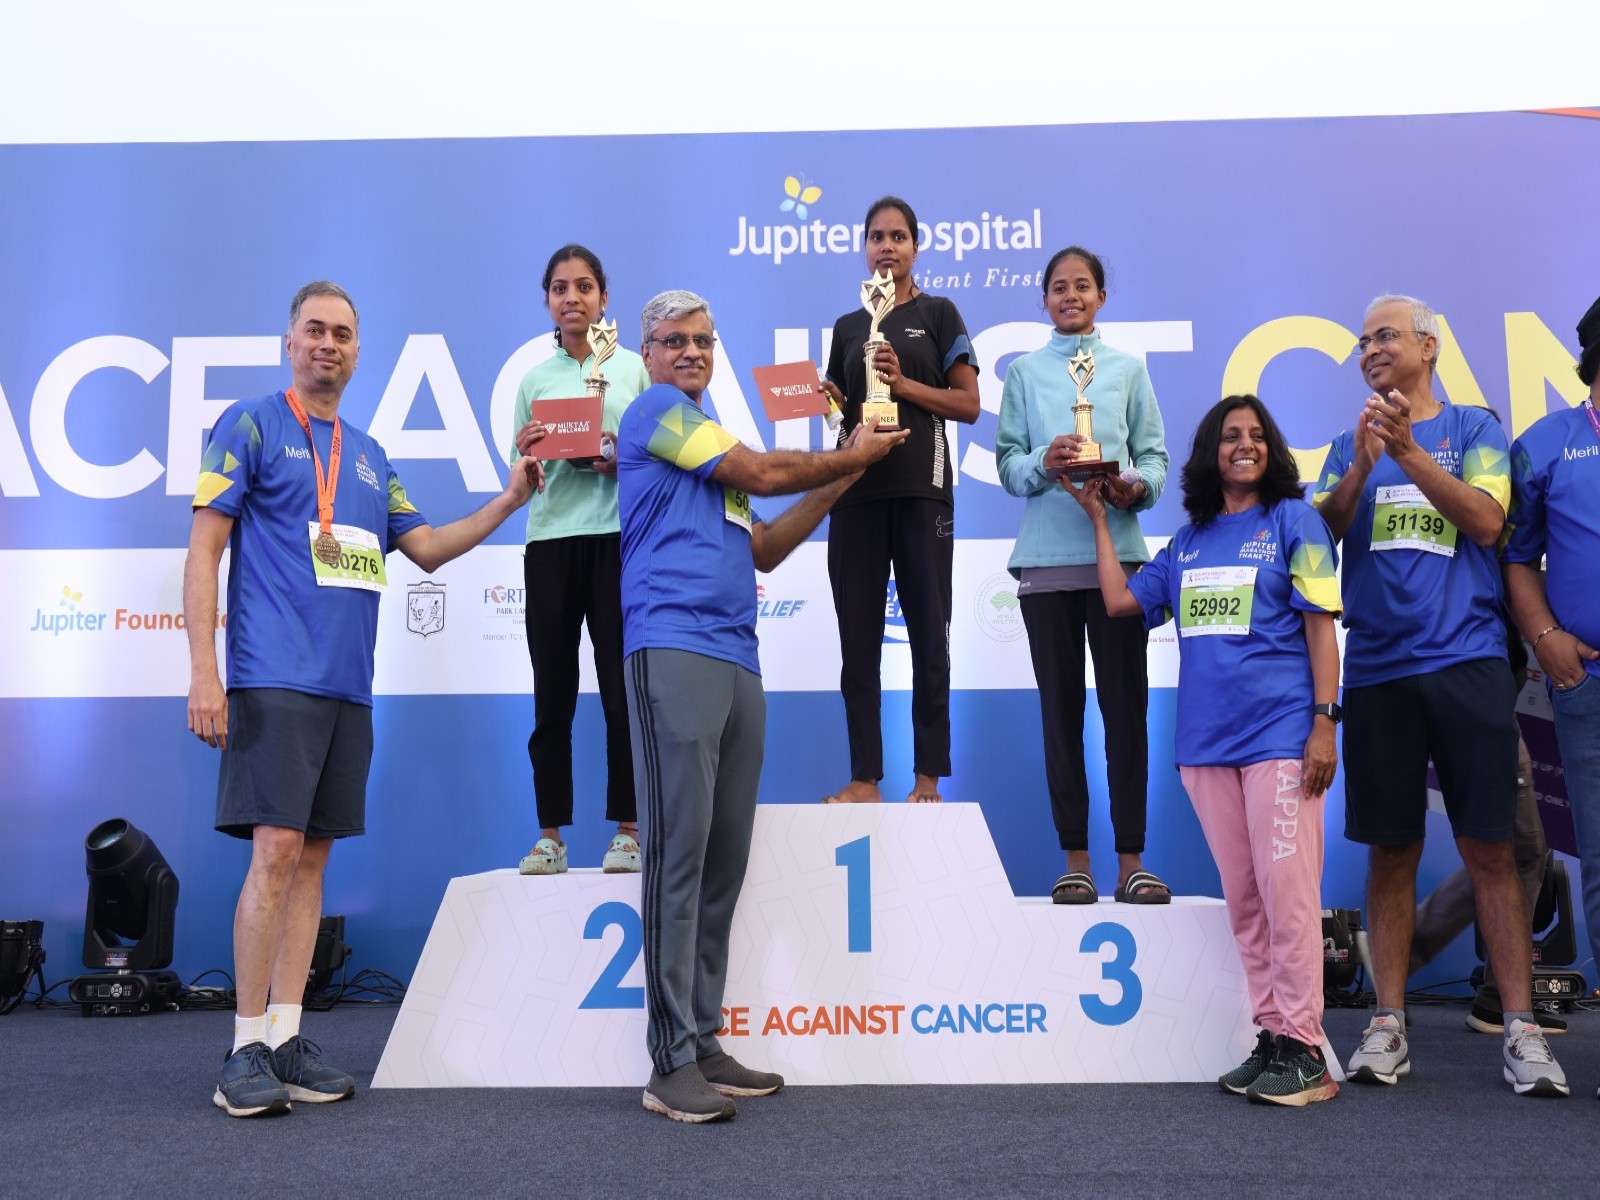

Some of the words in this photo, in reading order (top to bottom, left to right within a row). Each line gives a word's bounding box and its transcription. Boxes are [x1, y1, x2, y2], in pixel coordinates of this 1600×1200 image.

[729, 215, 865, 264] Jupiter
[915, 208, 1042, 261] ospital
[914, 270, 971, 289] tient
[983, 267, 1043, 288] First
[1564, 445, 1599, 460] Meril
[1386, 513, 1445, 535] 51139
[1242, 541, 1277, 550] JUPITER
[496, 607, 513, 615] PARK
[1189, 597, 1241, 618] 52992
[30, 608, 106, 636] Jupiter
[834, 835, 872, 953] 1
[577, 901, 644, 1010] 2
[1078, 921, 1143, 1026] 3
[761, 1004, 906, 1036] AGAINST
[910, 1002, 1048, 1035] CANCER
